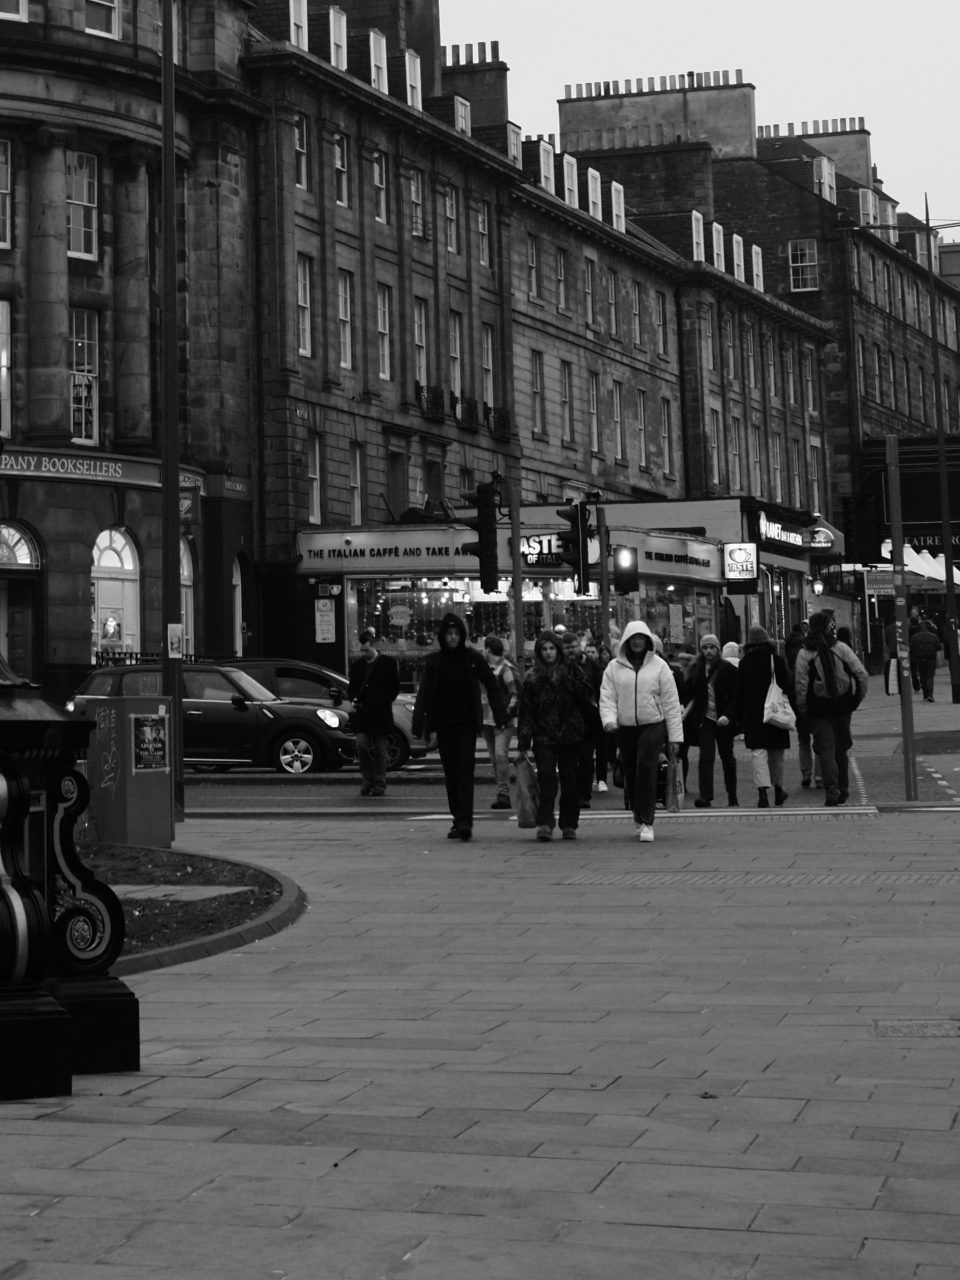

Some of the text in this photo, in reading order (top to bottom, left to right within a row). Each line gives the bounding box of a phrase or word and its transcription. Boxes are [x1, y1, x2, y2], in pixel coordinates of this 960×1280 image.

[41, 457, 123, 478] BOOKSELLERS
[519, 534, 564, 555] ASTE
[308, 549, 324, 559] THE
[328, 548, 366, 558] ITALIAN
[402, 548, 422, 557] AND
[425, 547, 450, 556] TAKE
[527, 554, 539, 564] OF
[728, 561, 754, 573] TASTE
